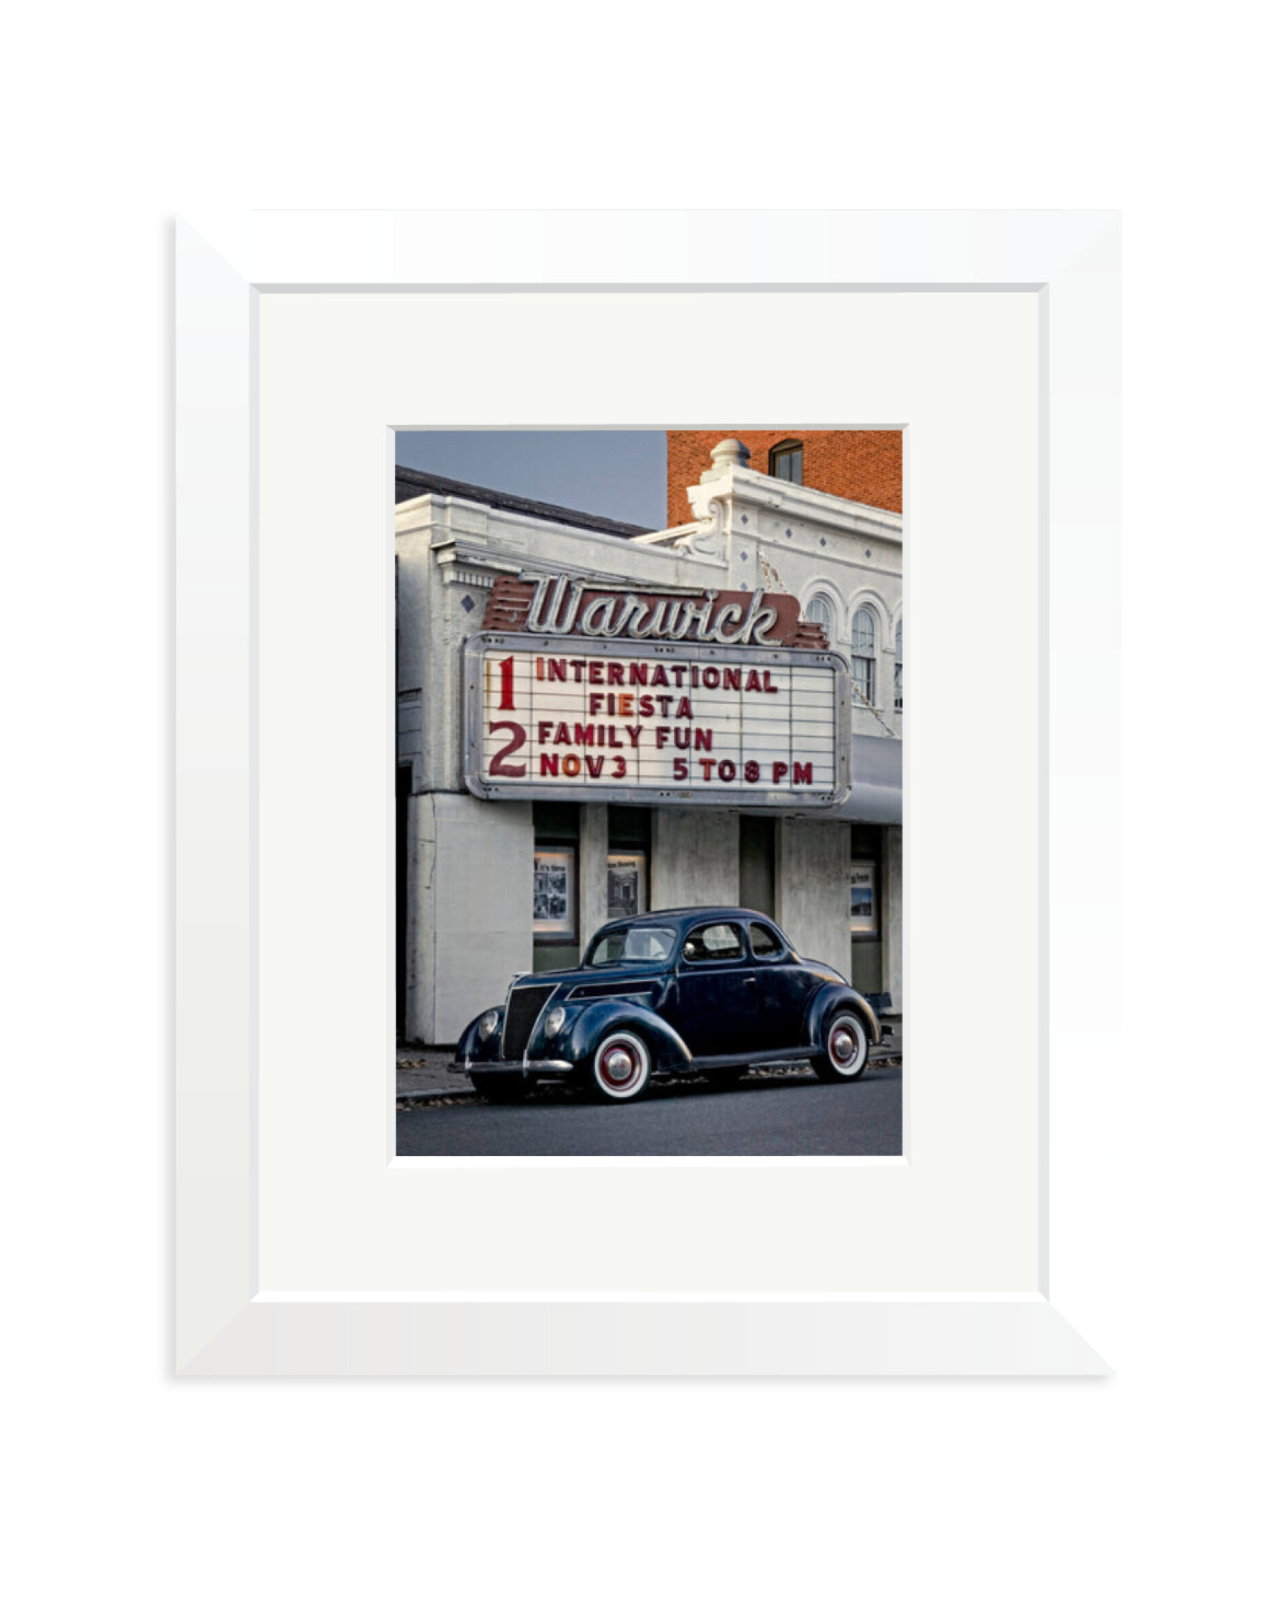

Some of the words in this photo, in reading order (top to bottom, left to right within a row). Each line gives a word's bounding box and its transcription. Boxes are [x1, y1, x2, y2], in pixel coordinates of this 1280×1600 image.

[521, 573, 782, 645] Warwick
[497, 655, 516, 710] 1
[536, 657, 778, 693] INTERNATIONAL
[589, 693, 694, 720] FIESTA
[488, 721, 527, 778] 2
[537, 721, 643, 748] FAMILY
[656, 726, 712, 752] FUN
[540, 753, 605, 778] NOV
[611, 755, 627, 779] 3
[673, 757, 688, 781] 5
[699, 758, 736, 782] TO
[744, 760, 760, 783] 8
[772, 761, 813, 785] PM
